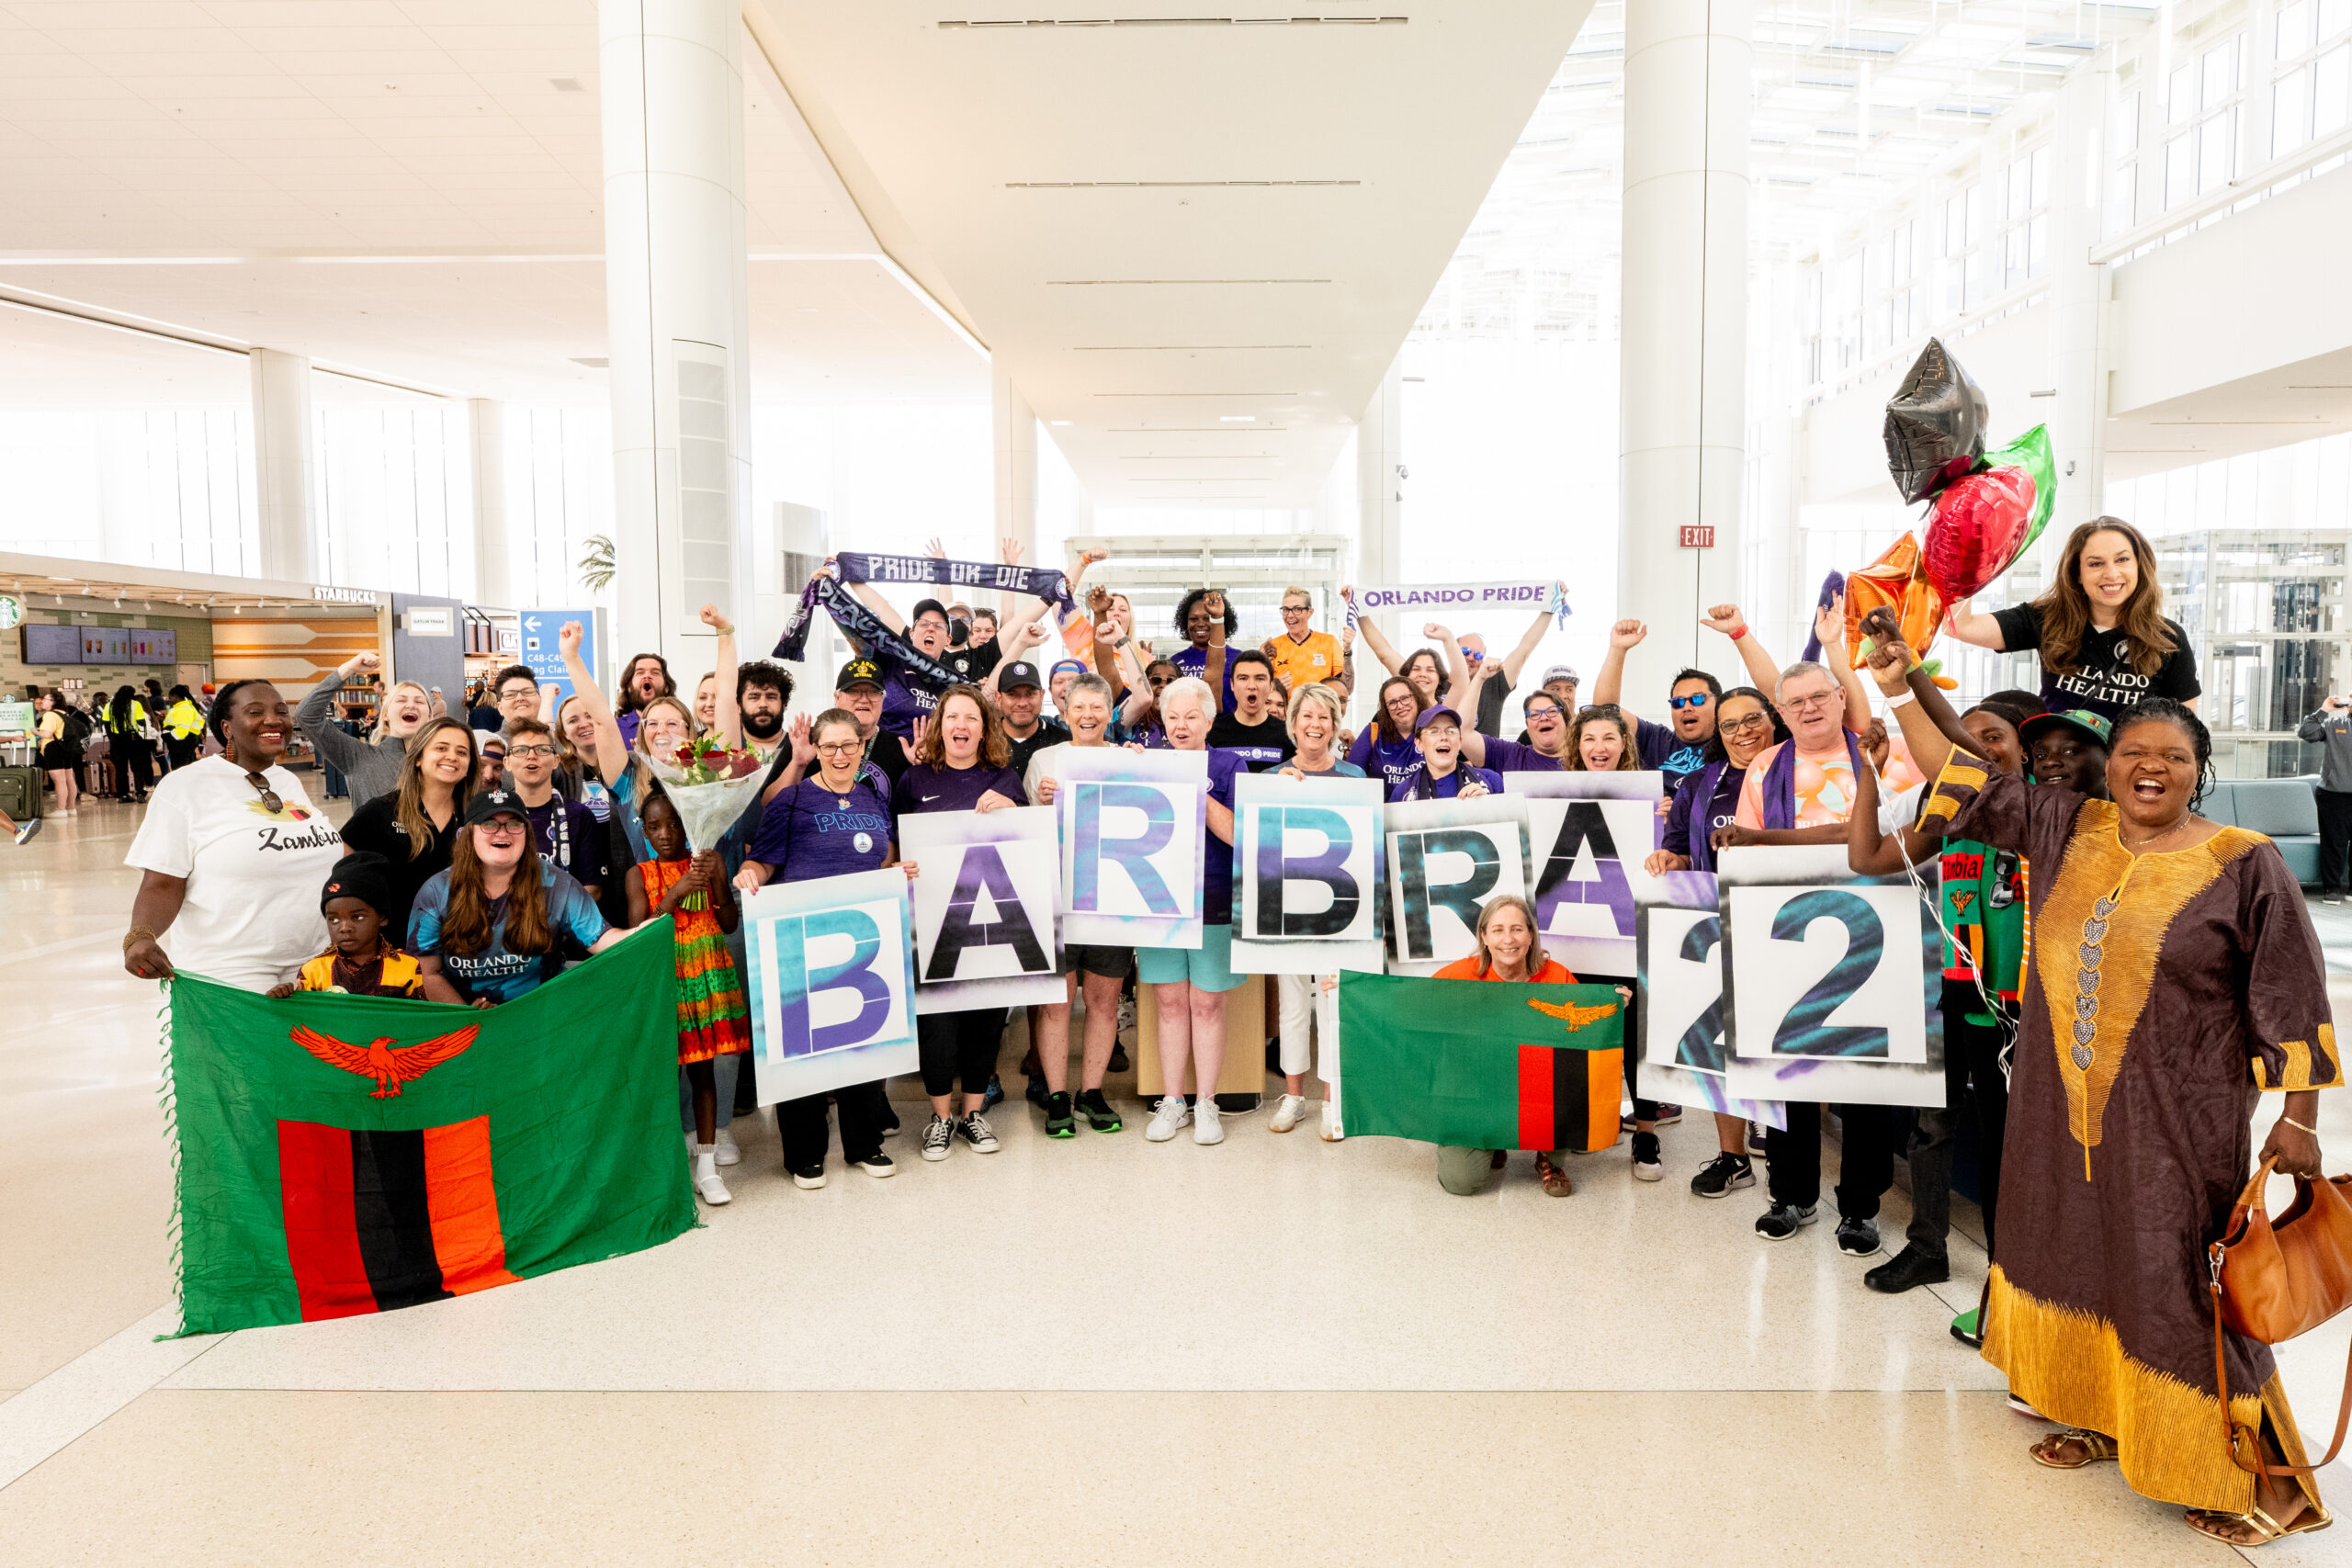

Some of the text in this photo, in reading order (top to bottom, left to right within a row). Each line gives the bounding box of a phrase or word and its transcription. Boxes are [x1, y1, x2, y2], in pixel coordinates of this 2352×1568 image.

[1685, 527, 1711, 546] EXIT
[867, 556, 935, 581] PRIDE
[995, 566, 1032, 591] DIE
[313, 586, 377, 604] STARBUCKS
[1364, 585, 1545, 607] ORLANDO PRIDE
[528, 665, 569, 675] ag Clai
[861, 660, 877, 671] ARMY
[2077, 664, 2150, 688] LANDO
[910, 688, 939, 702] ORLA
[915, 697, 937, 710] HEA
[258, 825, 343, 852] Zambia
[1072, 783, 1182, 915] R
[1256, 806, 1360, 936] B
[1534, 802, 1636, 937] A
[1397, 829, 1501, 960] R
[924, 844, 1051, 980] A
[449, 953, 532, 969] ORLANDO
[458, 964, 524, 977] HEALTH
[775, 908, 891, 1058] B
[1770, 889, 1889, 1058] 2
